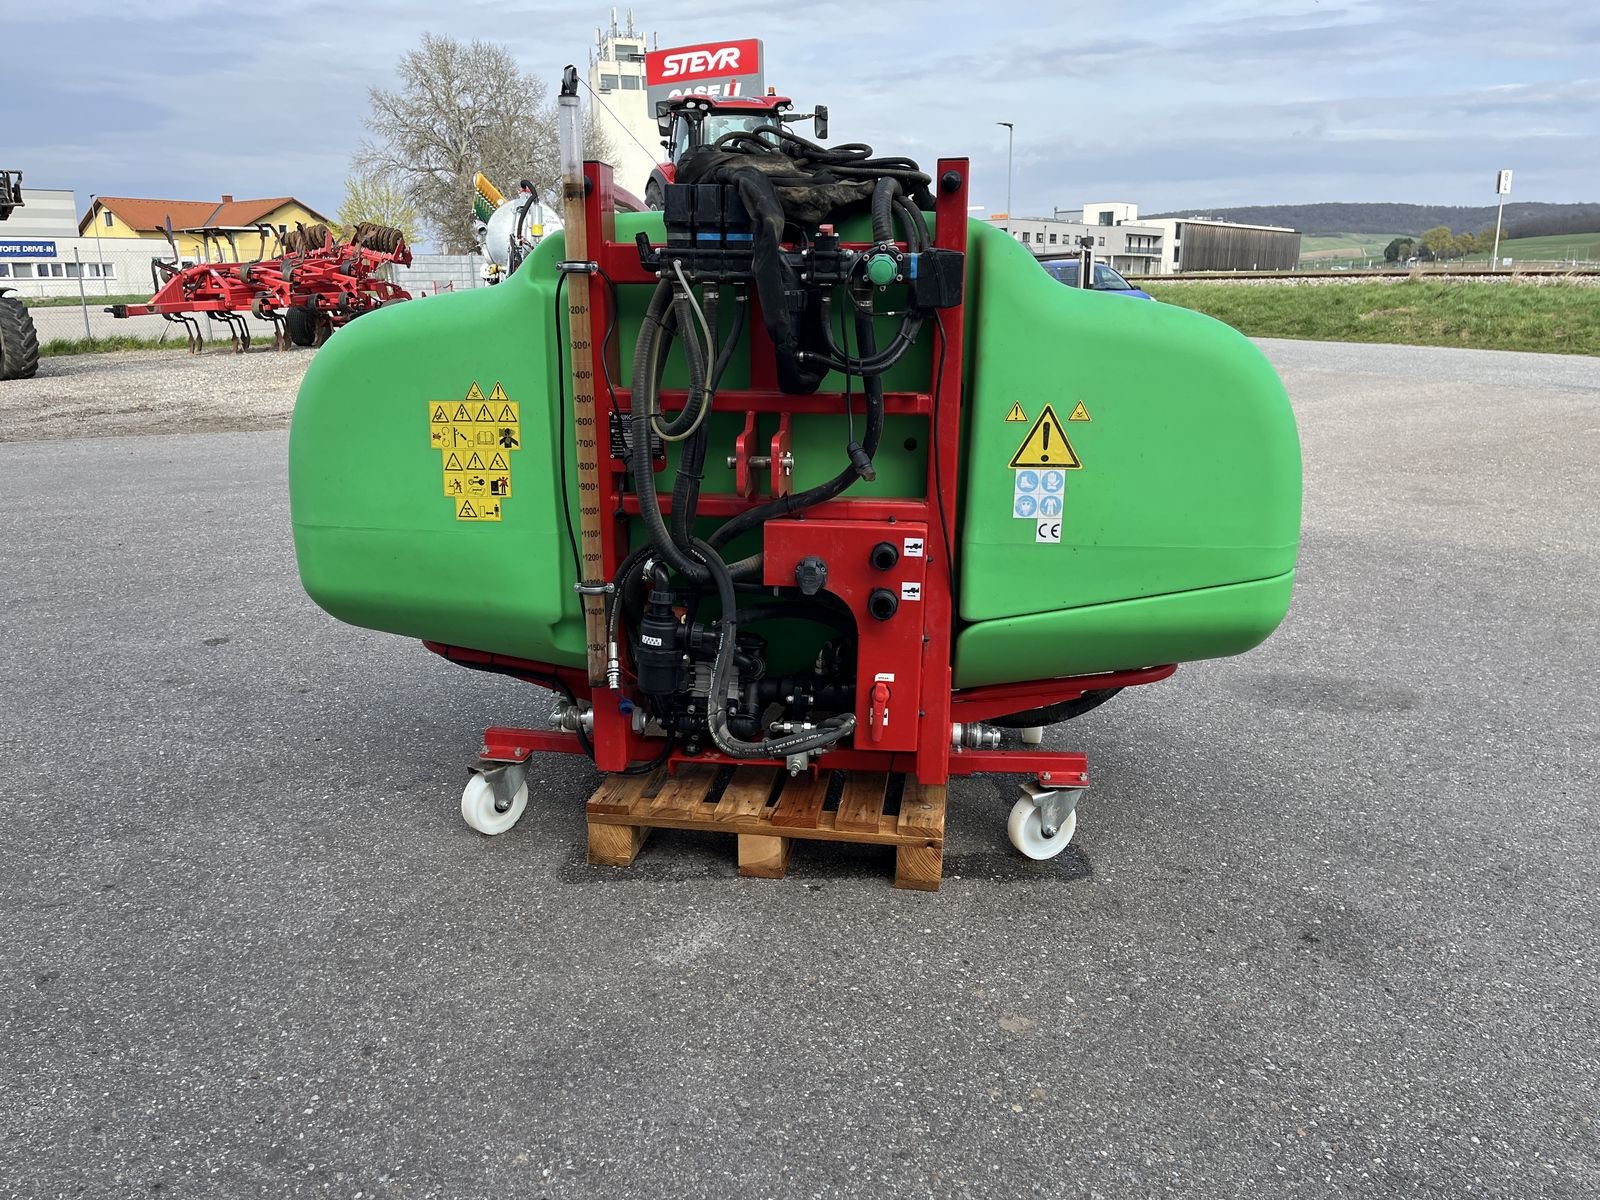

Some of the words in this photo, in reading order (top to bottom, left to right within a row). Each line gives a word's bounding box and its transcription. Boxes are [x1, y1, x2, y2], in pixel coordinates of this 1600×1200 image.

[661, 47, 740, 77] STEYR
[22, 245, 54, 253] DRIVE-IN
[570, 305, 585, 314] 200
[572, 341, 588, 349] 300
[575, 370, 591, 379] 400
[576, 394, 592, 403] 500
[577, 417, 593, 426] 600
[578, 439, 594, 447] 700
[579, 462, 595, 470] 800
[580, 482, 596, 491] 900
[582, 507, 597, 515] 1000
[583, 530, 599, 538] 1100
[1038, 523, 1060, 538] CE
[585, 553, 600, 561] 1200
[588, 607, 603, 616] 1400
